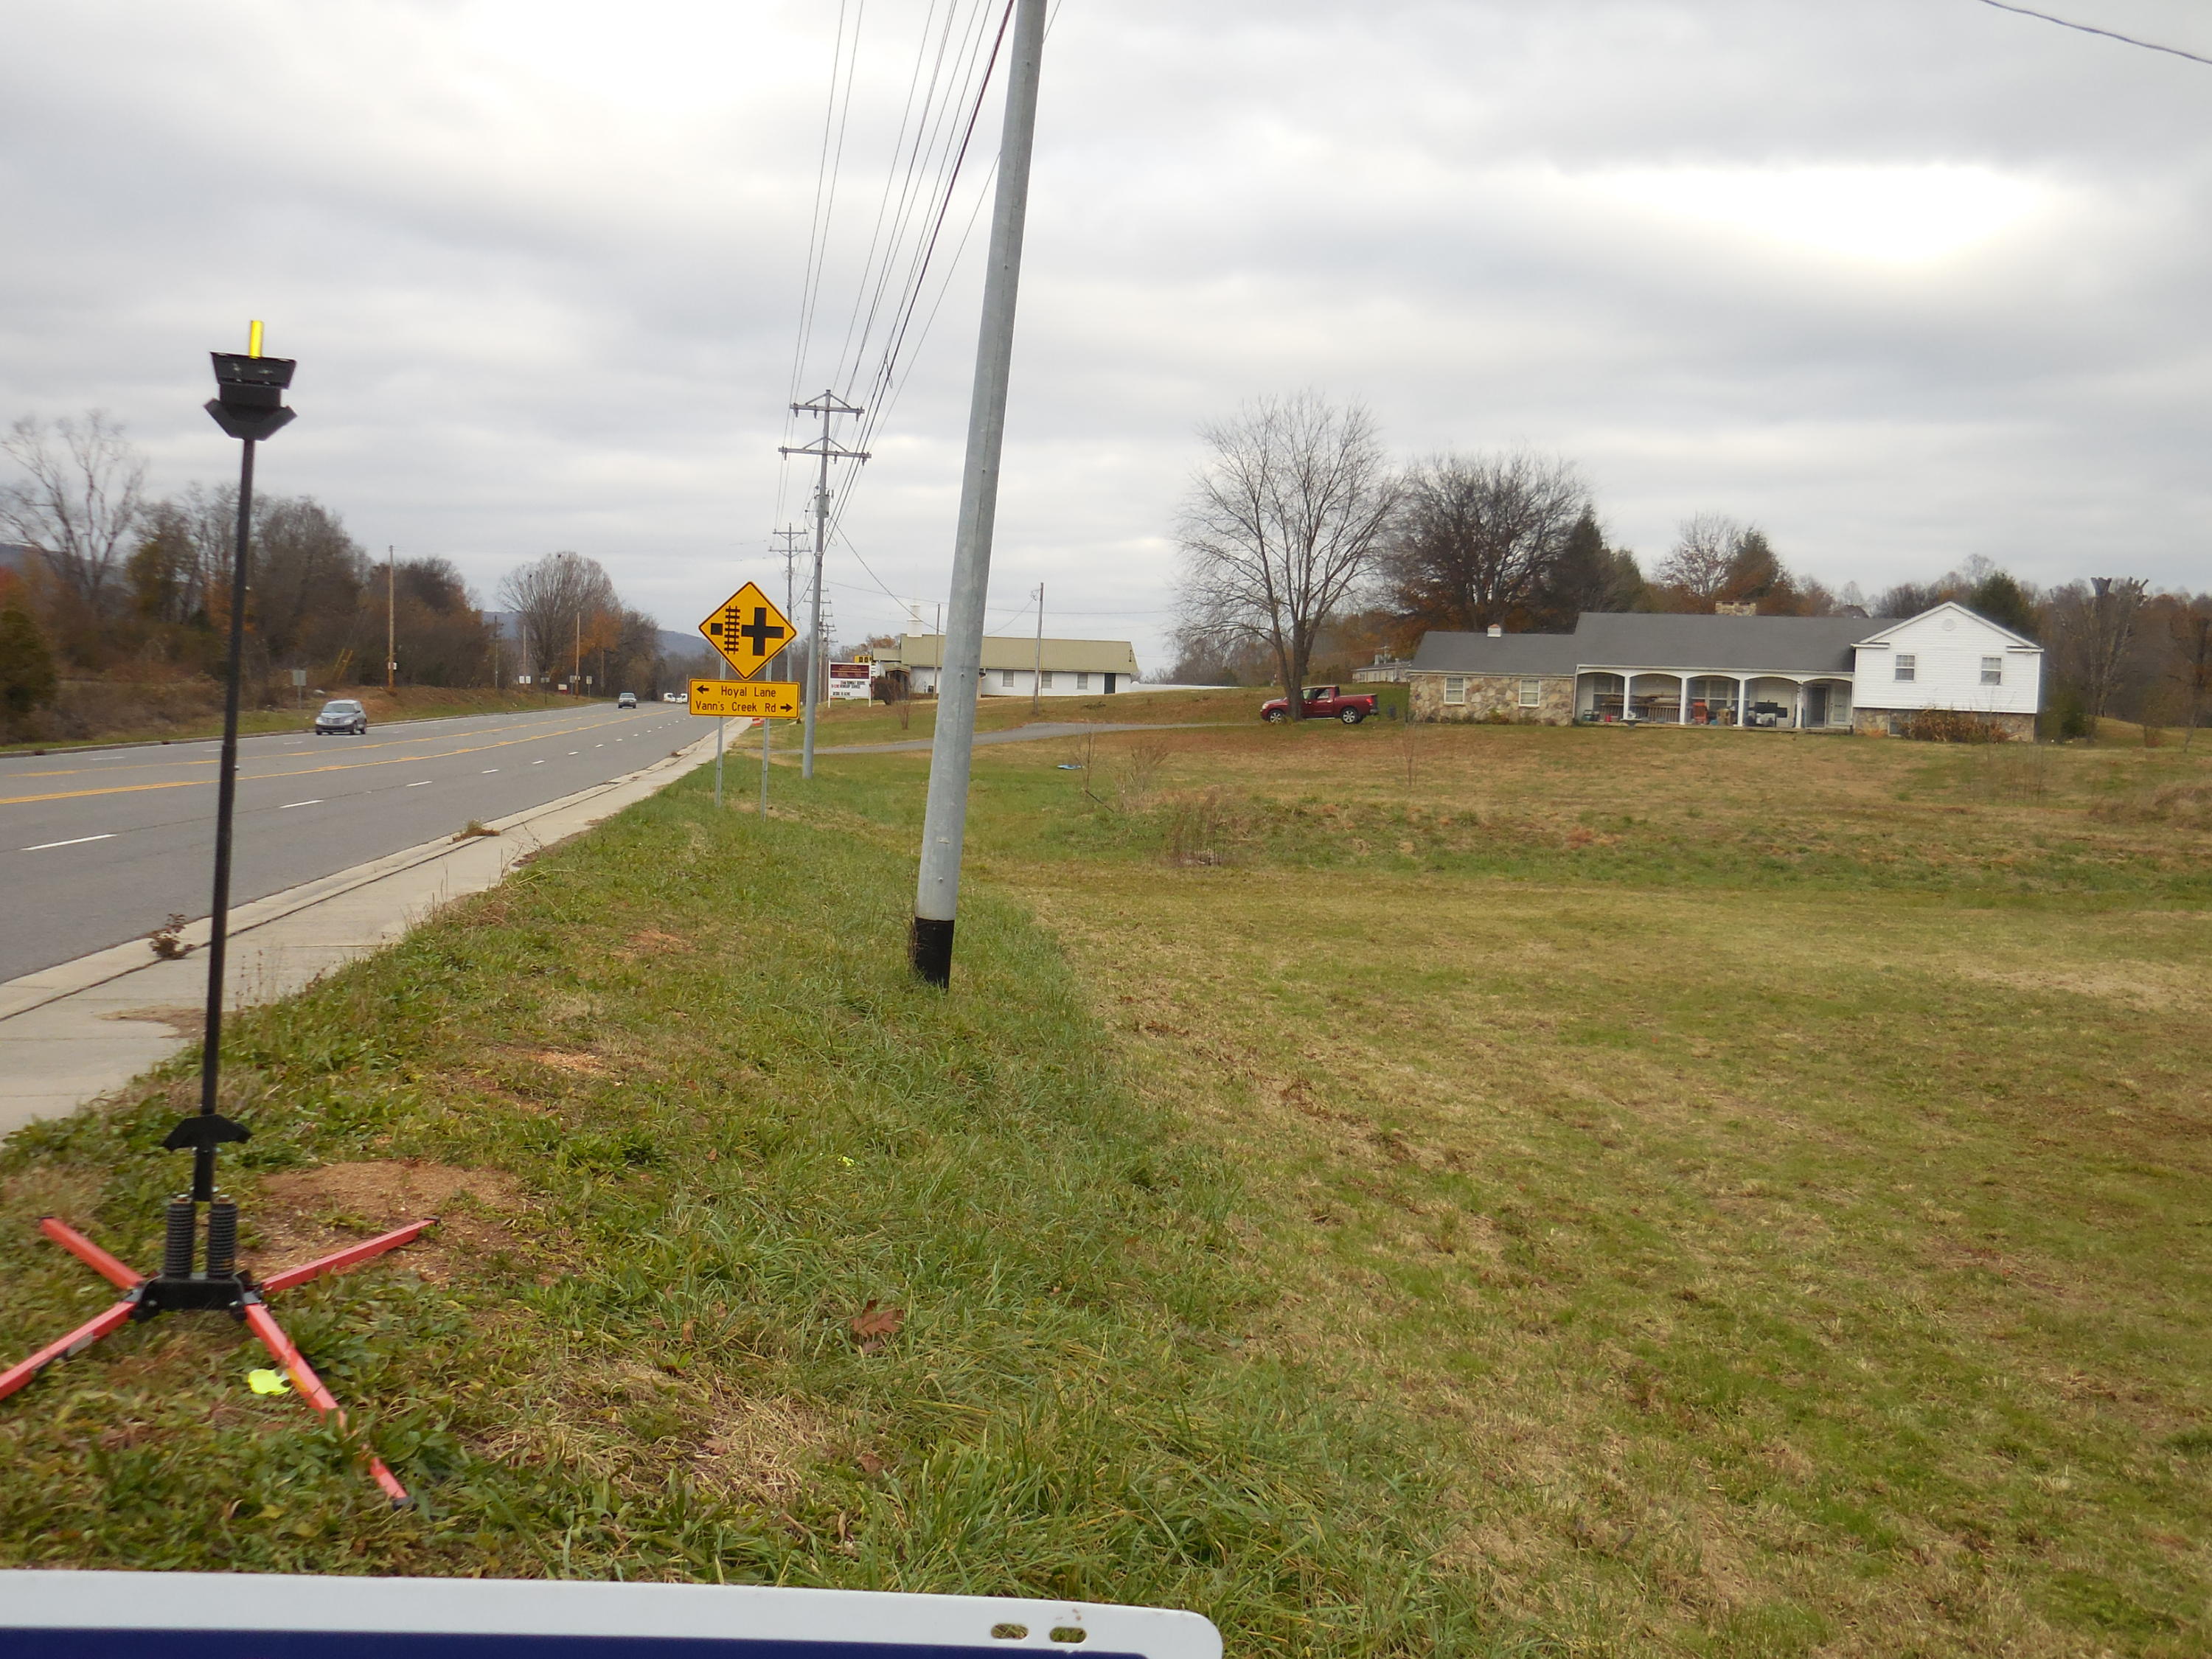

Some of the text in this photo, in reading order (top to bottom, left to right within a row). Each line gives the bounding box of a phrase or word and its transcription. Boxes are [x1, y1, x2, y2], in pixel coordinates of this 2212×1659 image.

[721, 686, 776, 698] Hoyal Lane
[695, 700, 776, 713] Vann's Creek Rd
